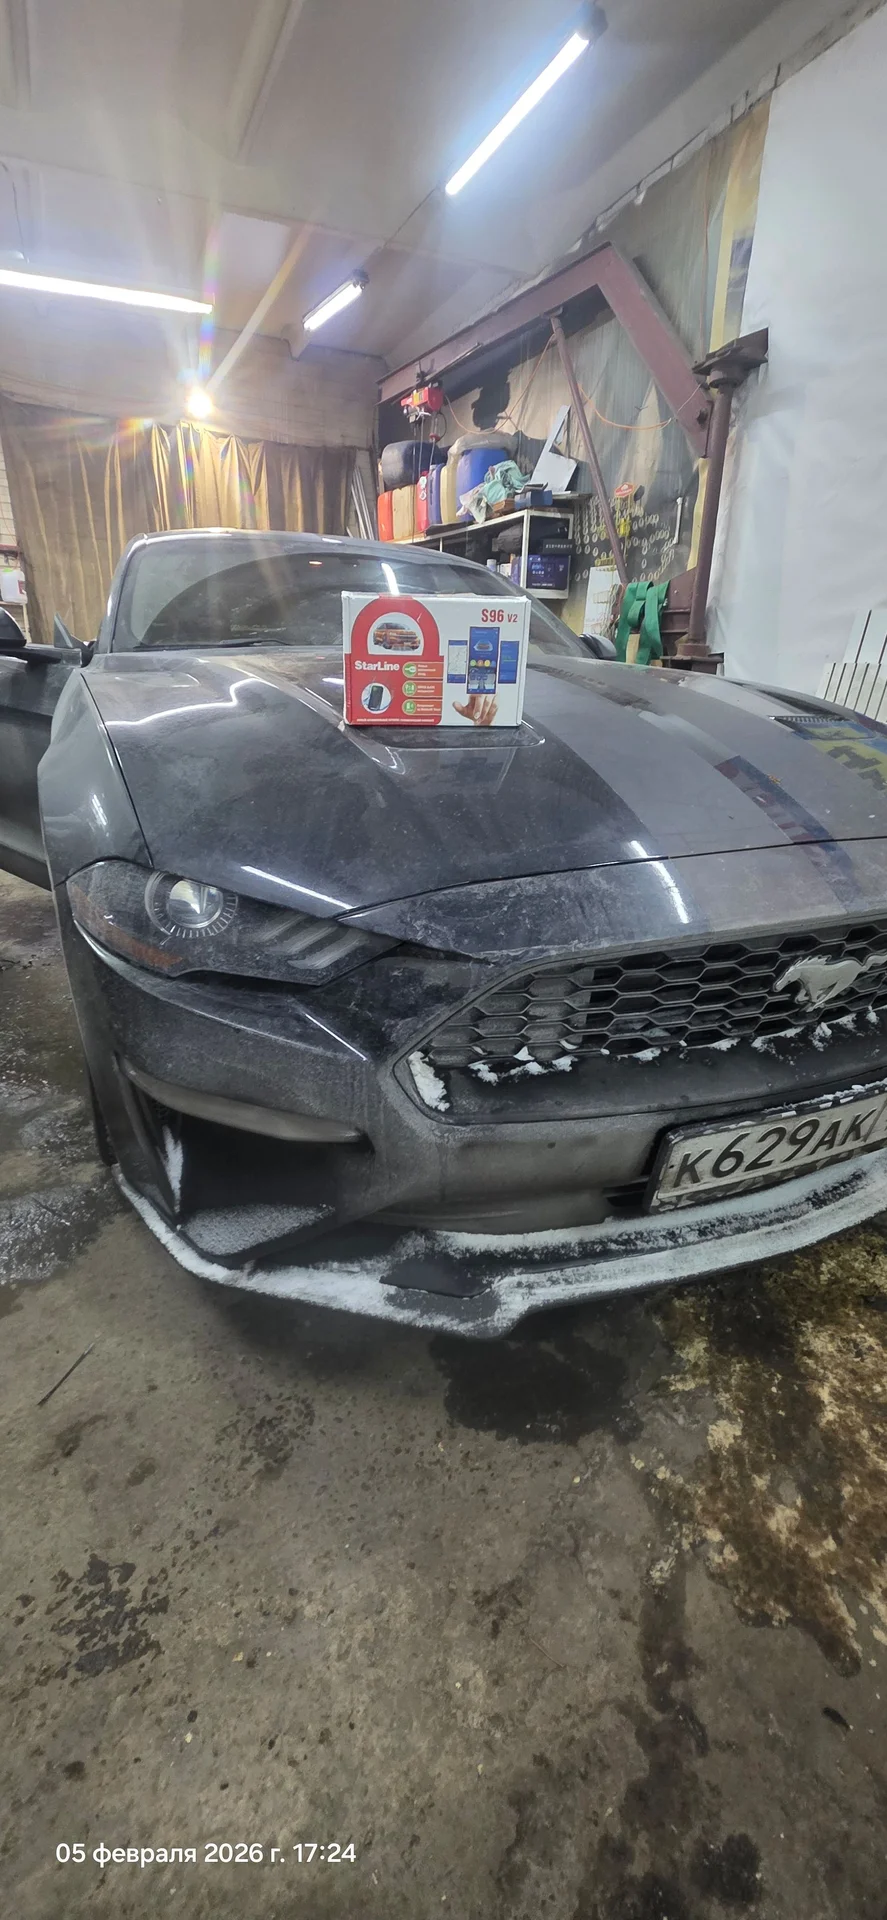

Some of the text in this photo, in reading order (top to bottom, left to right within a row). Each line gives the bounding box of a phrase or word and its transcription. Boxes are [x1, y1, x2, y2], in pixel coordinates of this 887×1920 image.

[481, 608, 518, 623] S96 V2
[354, 660, 400, 671] StarLine
